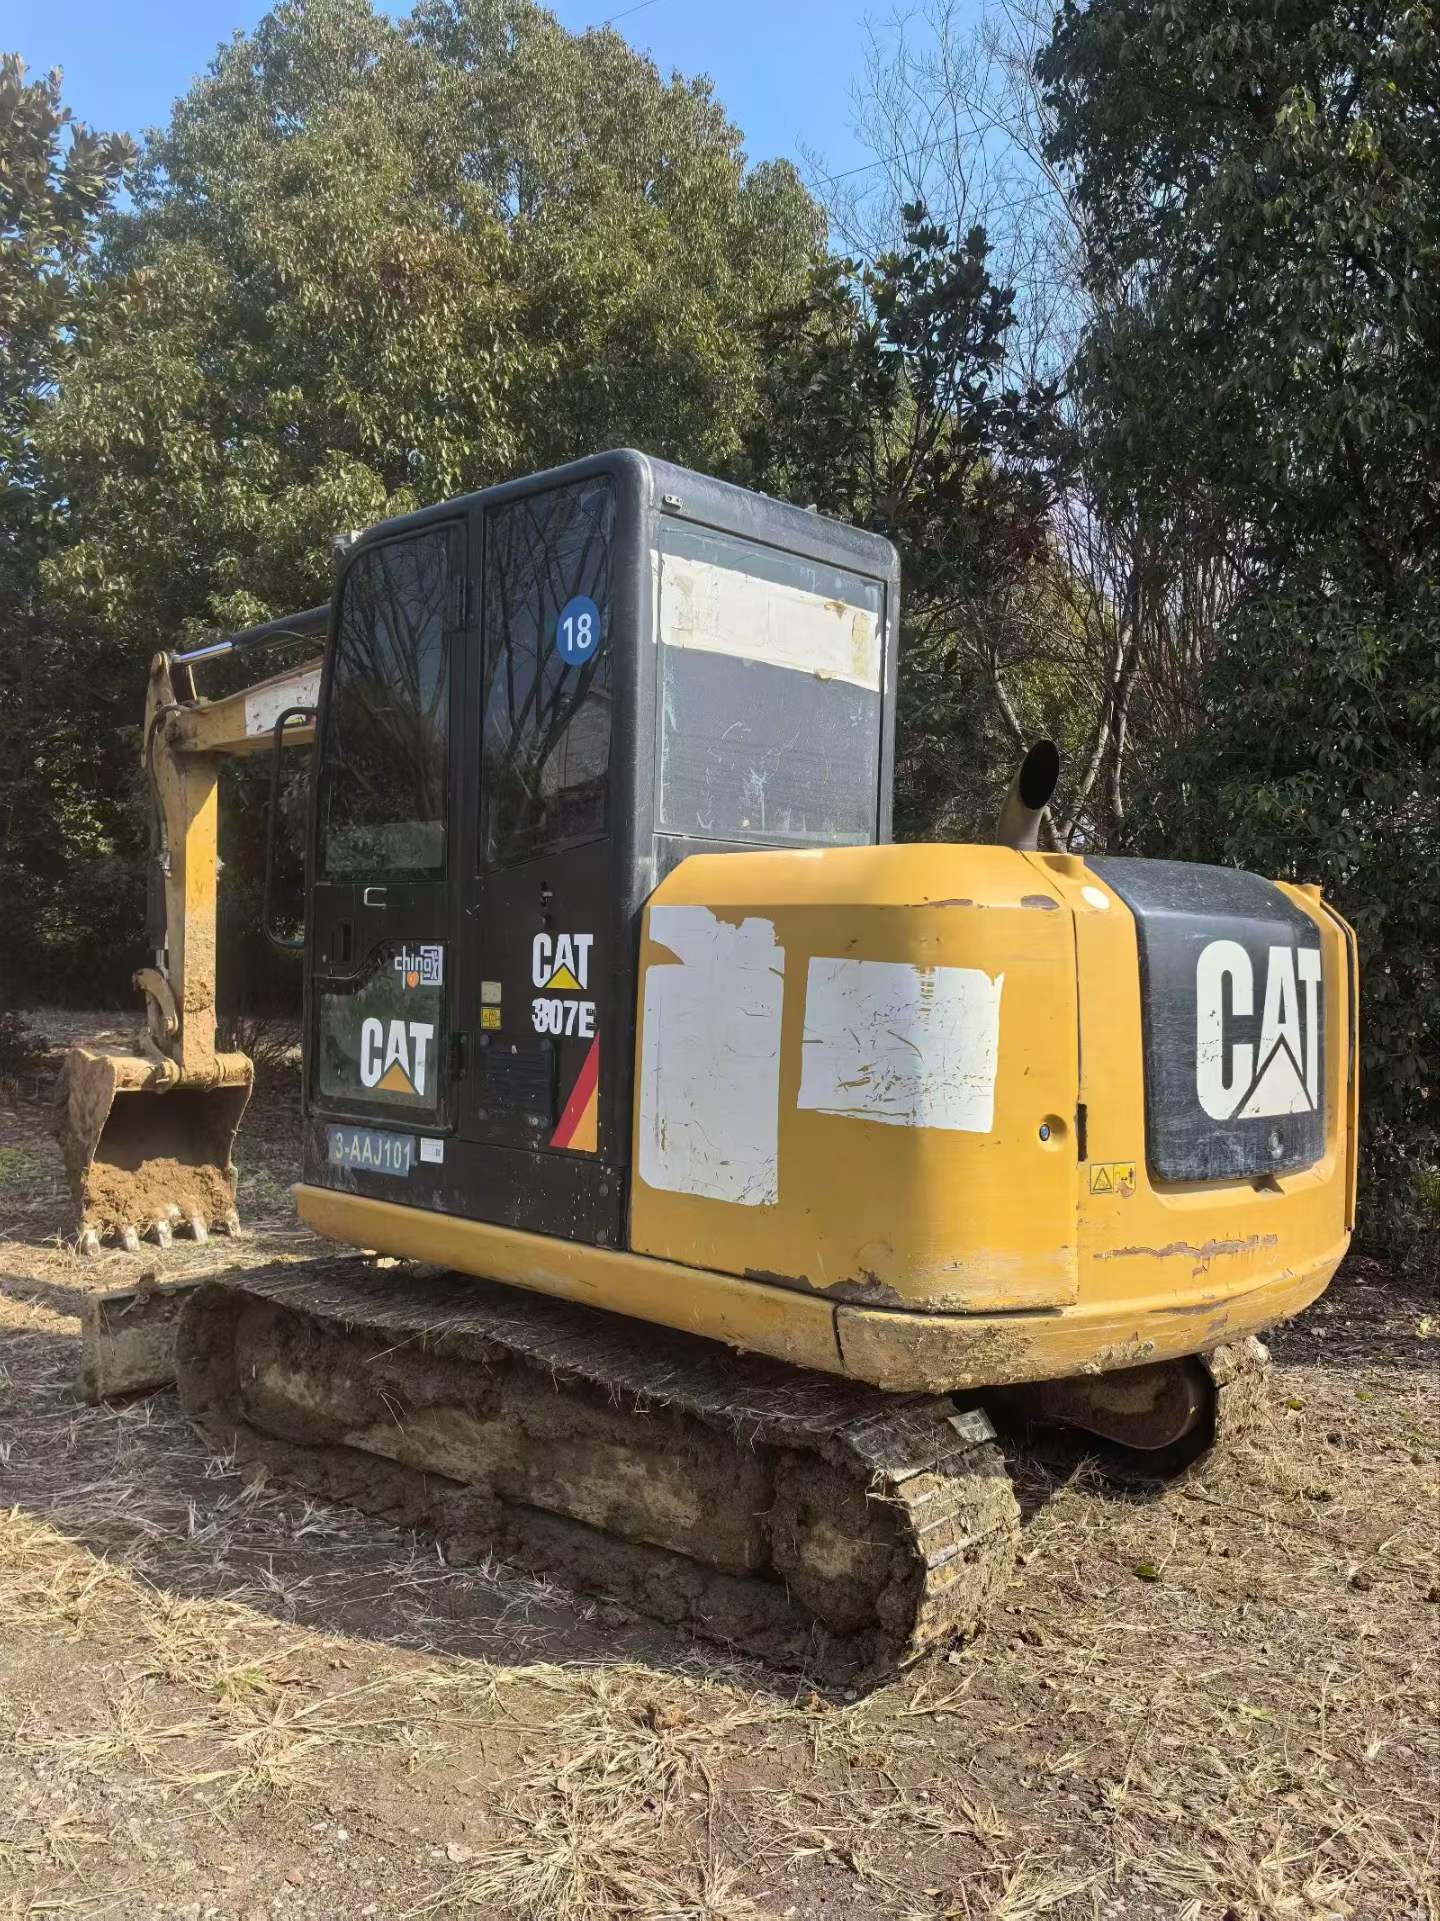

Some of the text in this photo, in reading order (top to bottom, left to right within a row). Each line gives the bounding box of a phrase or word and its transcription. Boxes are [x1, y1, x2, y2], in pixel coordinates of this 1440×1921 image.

[563, 613, 592, 652] 18
[532, 933, 594, 989] CAT
[531, 998, 597, 1038] 307E
[1196, 939, 1322, 1120] CAT
[360, 1017, 434, 1096] CAT
[335, 1132, 411, 1172] 3-AAJ101
